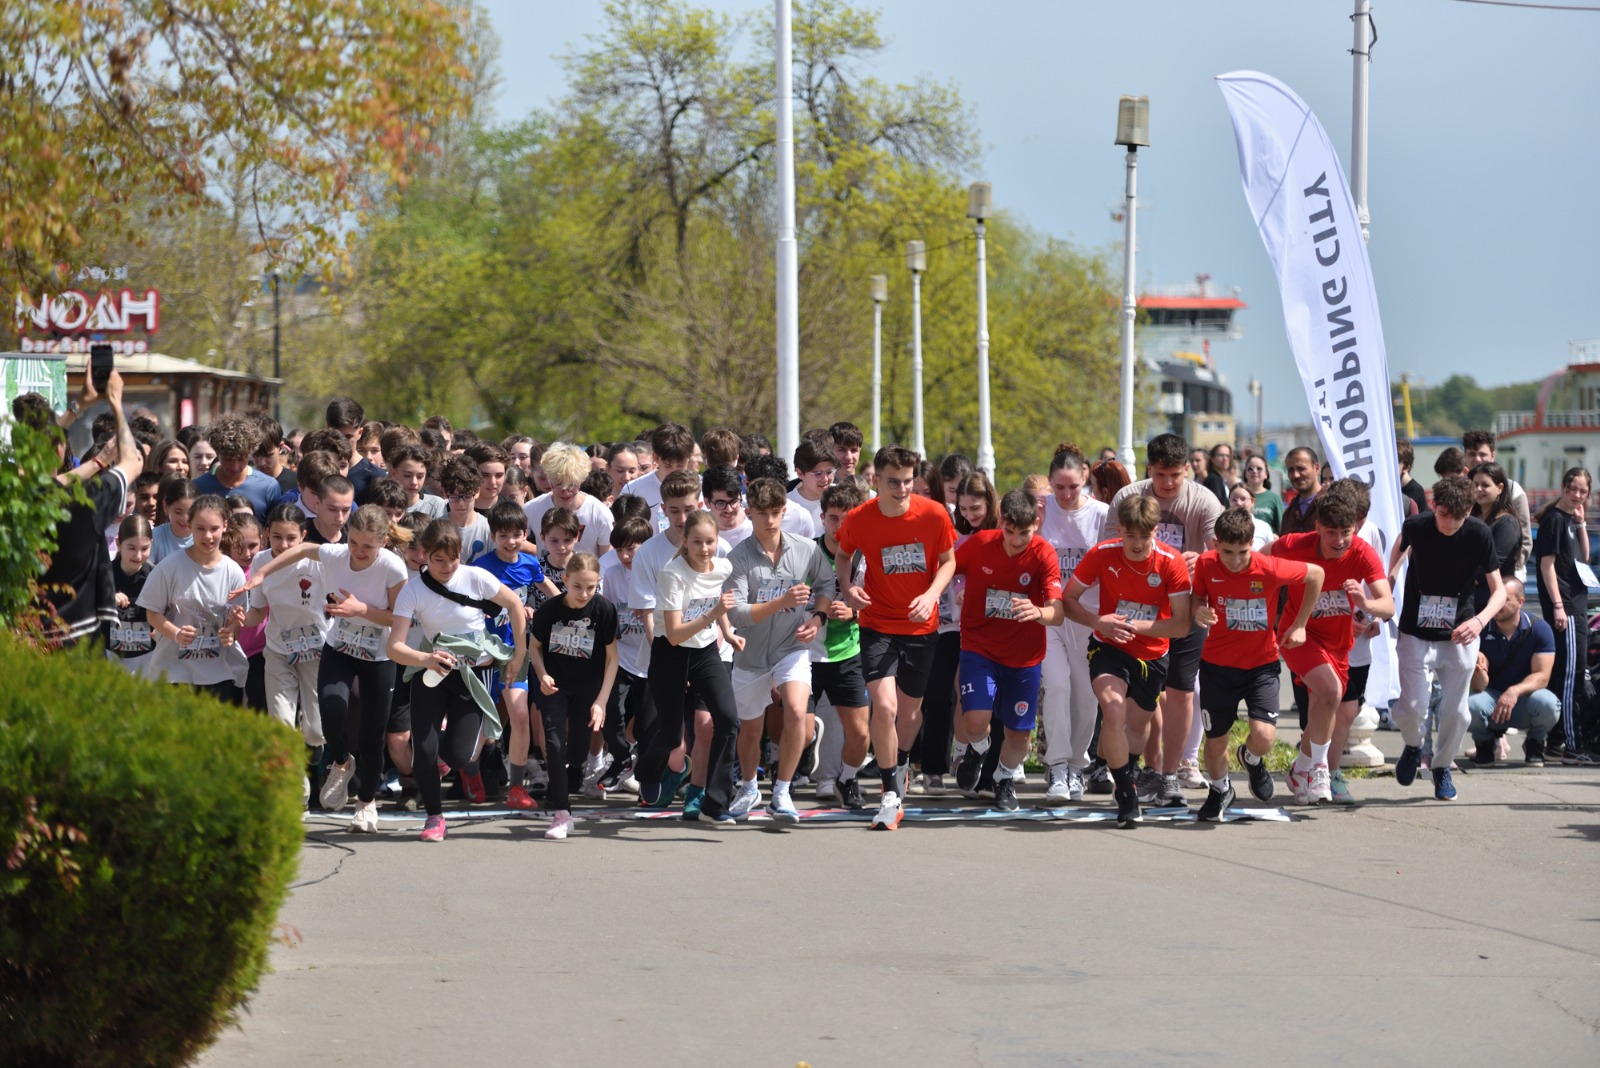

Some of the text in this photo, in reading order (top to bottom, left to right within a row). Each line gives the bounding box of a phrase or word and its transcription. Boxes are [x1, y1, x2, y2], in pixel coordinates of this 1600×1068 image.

[15, 290, 157, 331] NOAH
[21, 336, 55, 353] bar
[79, 336, 147, 356] longe
[894, 551, 912, 566] 83
[1319, 597, 1338, 610] 84
[1237, 607, 1256, 621] 110
[1428, 604, 1444, 619] 45
[125, 629, 134, 643] 8
[195, 635, 205, 651] 7
[298, 635, 309, 652] 3
[351, 632, 362, 648] 4
[565, 634, 581, 649] 19
[960, 682, 975, 696] 21
